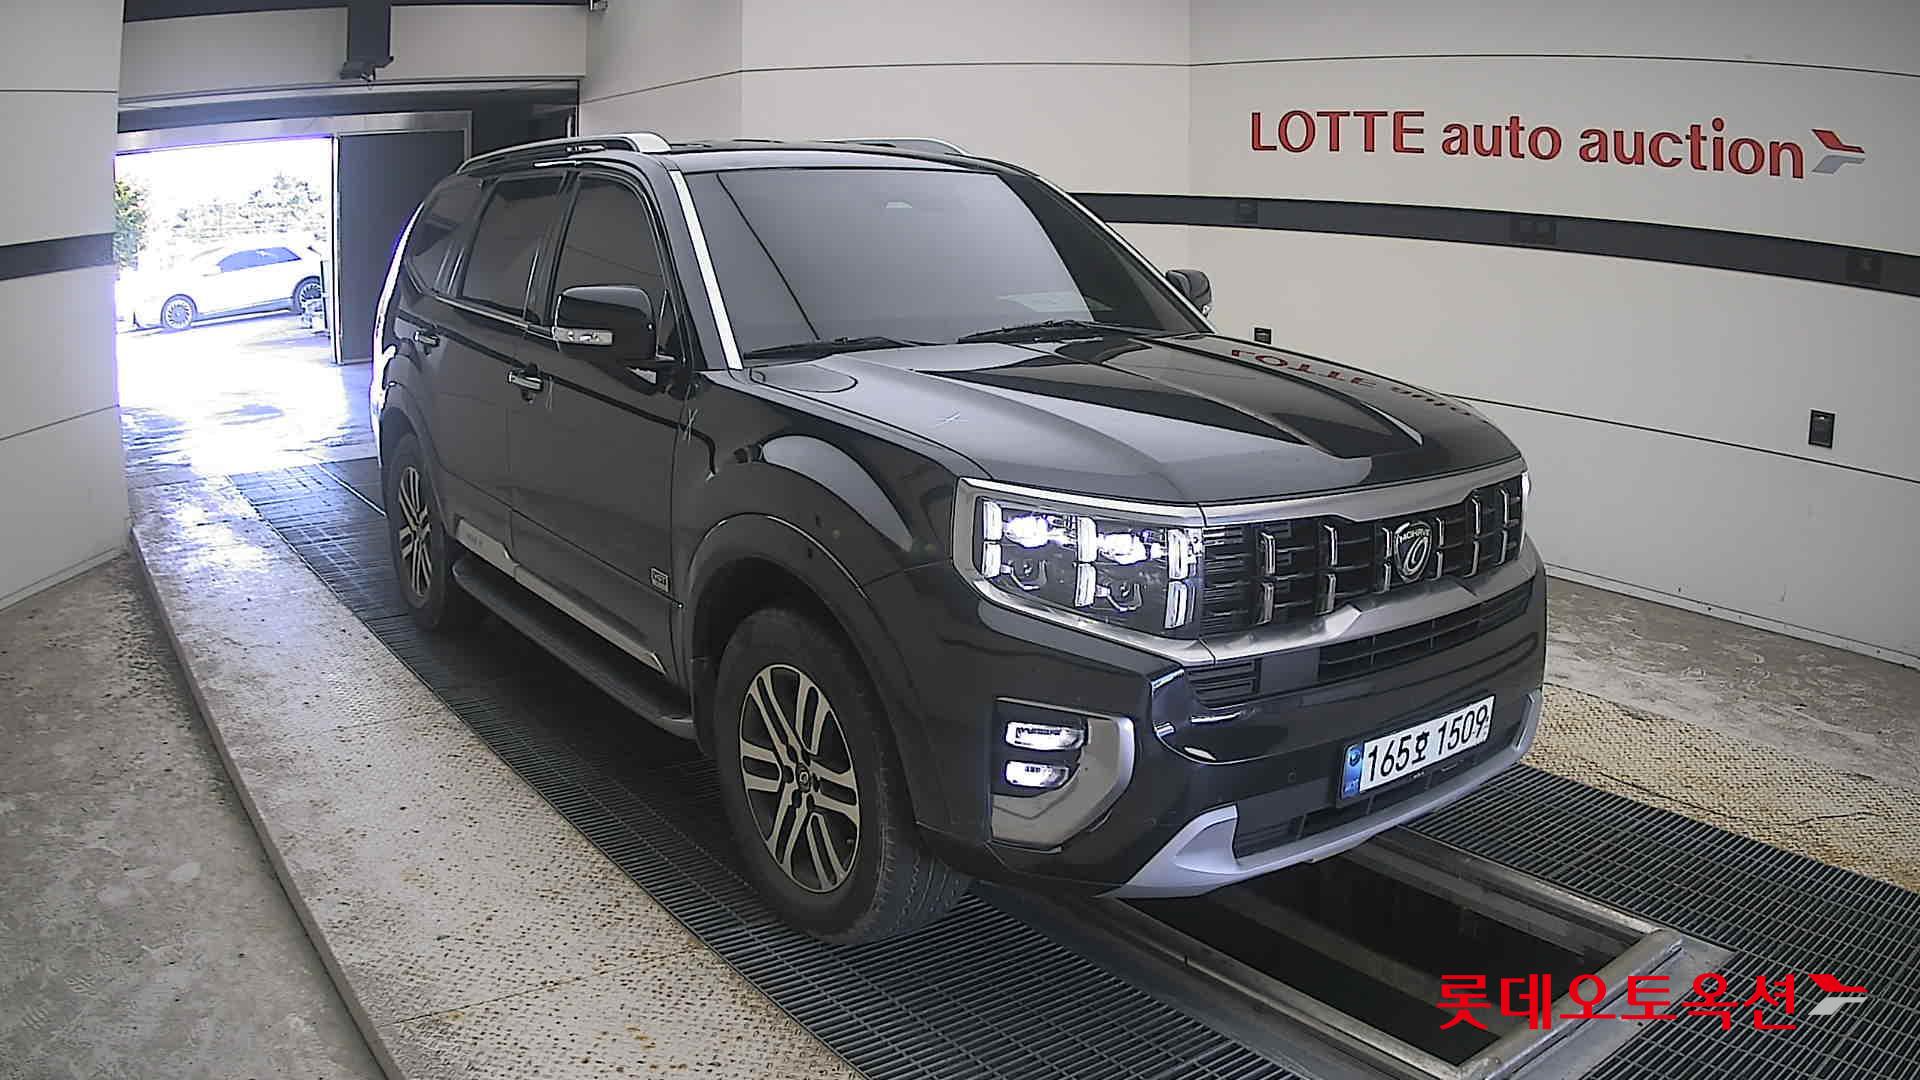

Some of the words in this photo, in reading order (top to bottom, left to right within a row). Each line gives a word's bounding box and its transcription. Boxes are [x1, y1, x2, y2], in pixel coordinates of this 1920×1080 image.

[1250, 110, 1425, 154] LOTTE
[1441, 115, 1562, 161] auto
[1578, 117, 1804, 179] auction
[1368, 731, 1429, 782] 165호
[1438, 704, 1489, 755] 1509
